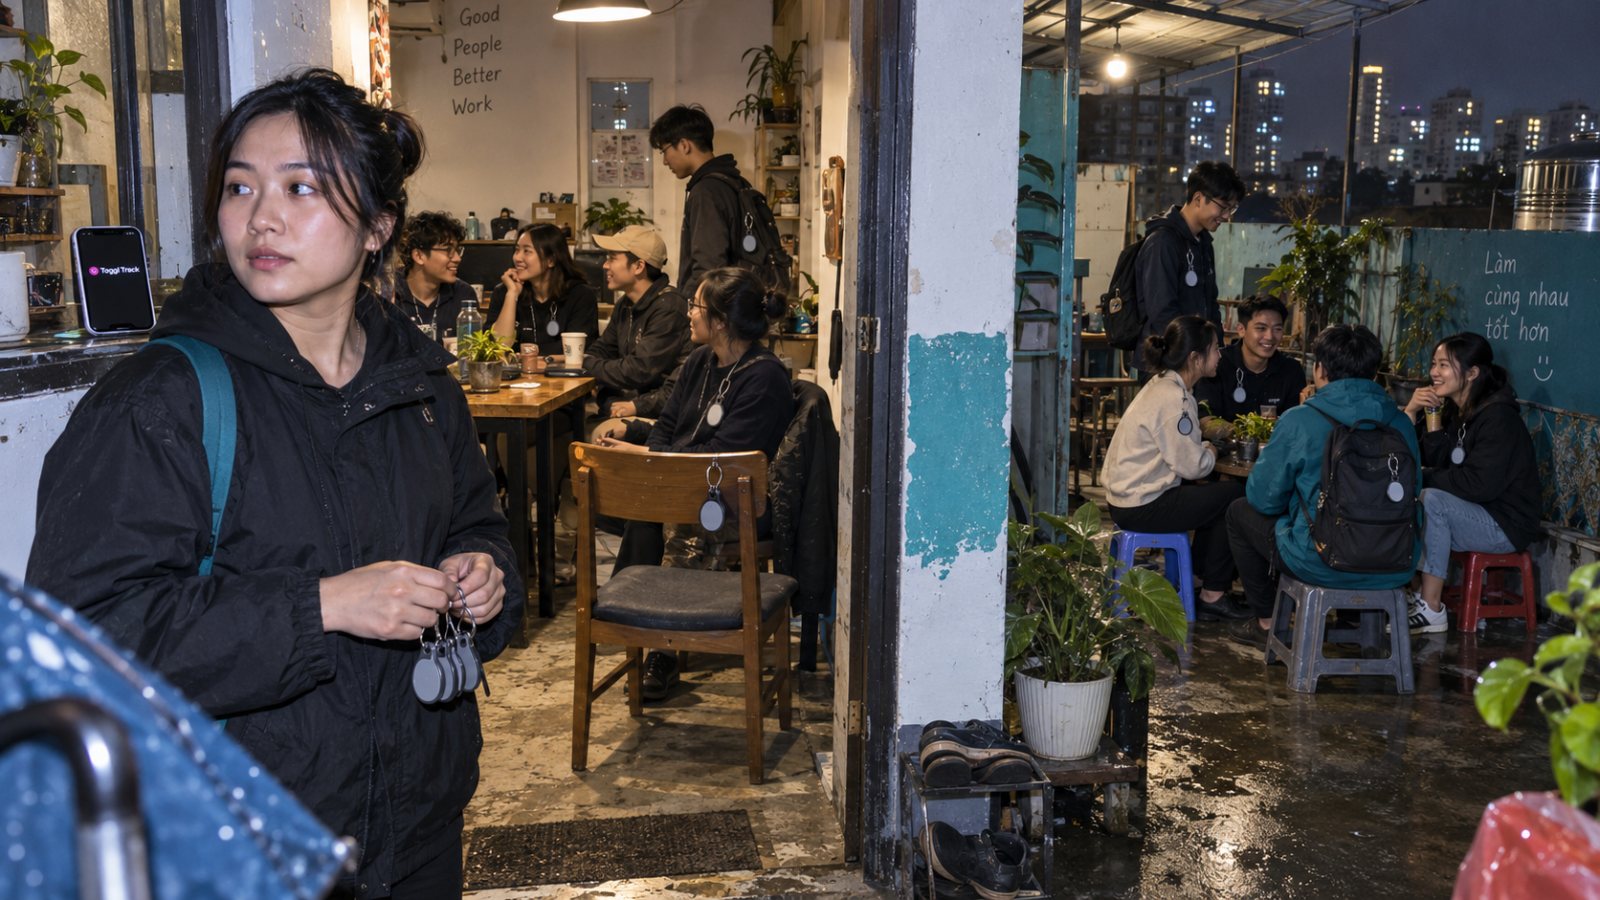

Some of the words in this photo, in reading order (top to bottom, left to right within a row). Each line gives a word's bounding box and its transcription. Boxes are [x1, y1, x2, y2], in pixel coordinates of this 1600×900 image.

[460, 4, 500, 27] Good
[454, 34, 502, 59] People
[453, 66, 502, 86] Better
[452, 94, 493, 115] Work
[100, 267, 120, 275] Toggl
[1485, 250, 1516, 274] Làm
[1485, 284, 1520, 315] cùng
[1529, 281, 1568, 307] nhau
[1485, 314, 1510, 340] tốt
[1519, 316, 1549, 342] hơn
